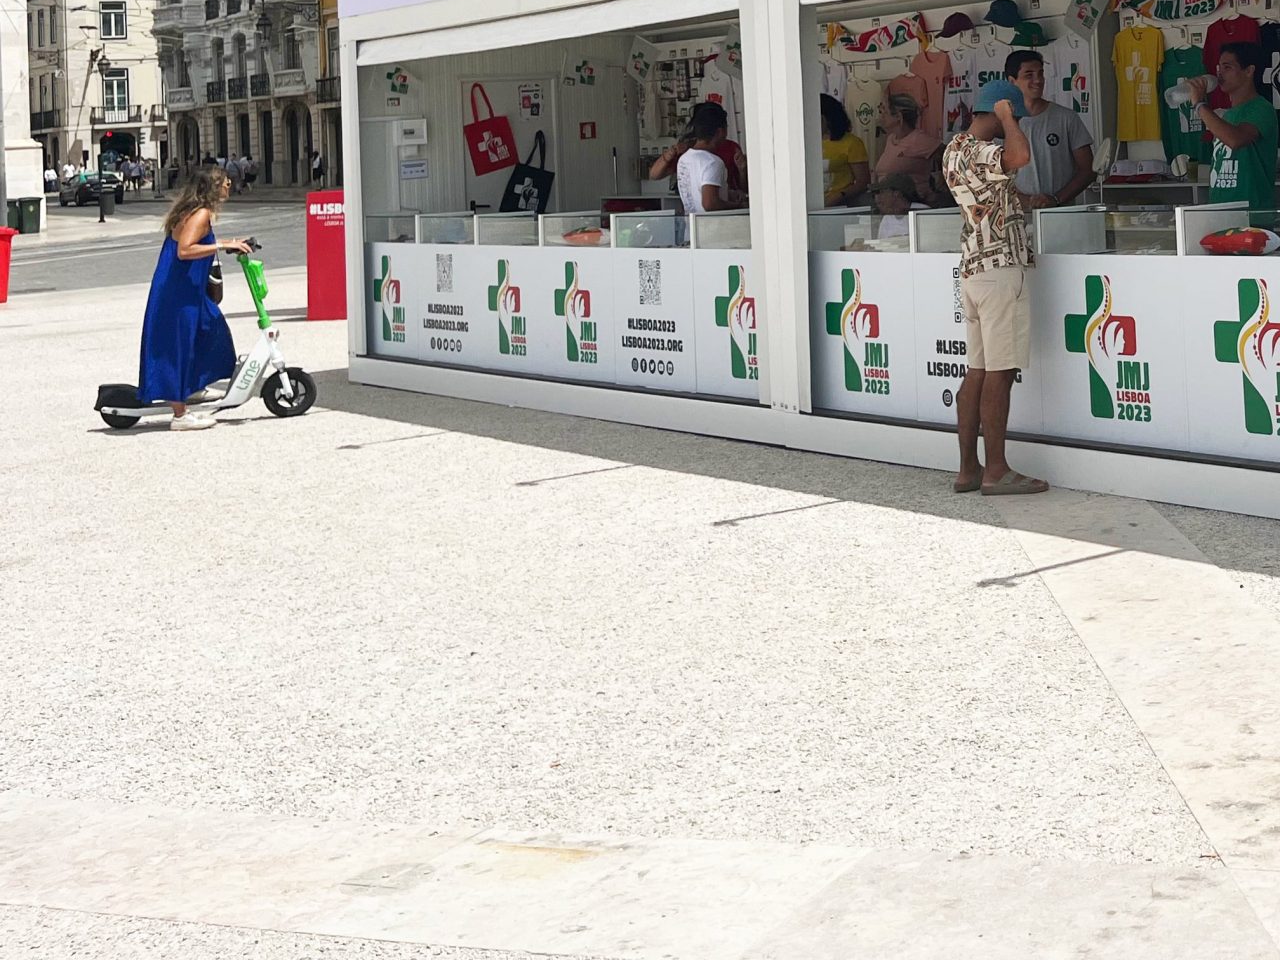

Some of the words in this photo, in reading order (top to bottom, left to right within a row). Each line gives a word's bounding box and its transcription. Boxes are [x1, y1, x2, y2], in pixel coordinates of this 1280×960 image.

[1184, 0, 1216, 19] 2023
[1216, 179, 1238, 189] 2023
[310, 203, 345, 215] #LISB
[392, 307, 405, 324] JMJ
[428, 303, 464, 316] #LISBOA2023
[423, 318, 469, 333] LISBOA2023.ORG
[511, 316, 526, 336] JMJ
[580, 321, 597, 342] JMJ
[627, 317, 676, 333] #LISBOA2023
[392, 332, 406, 343] 2023
[621, 335, 683, 352] LISBOA2023.ORG
[511, 344, 527, 356] 2023
[580, 342, 598, 351] LISBOA
[580, 351, 598, 364] 2023
[748, 357, 757, 365] LIS
[864, 342, 888, 368] JMJ
[748, 367, 758, 380] 20
[864, 368, 890, 379] LISBOA
[1116, 360, 1150, 391] JMJ
[865, 380, 890, 395] 2023
[1116, 390, 1151, 404] LISBOA
[1117, 403, 1152, 422] 2023
